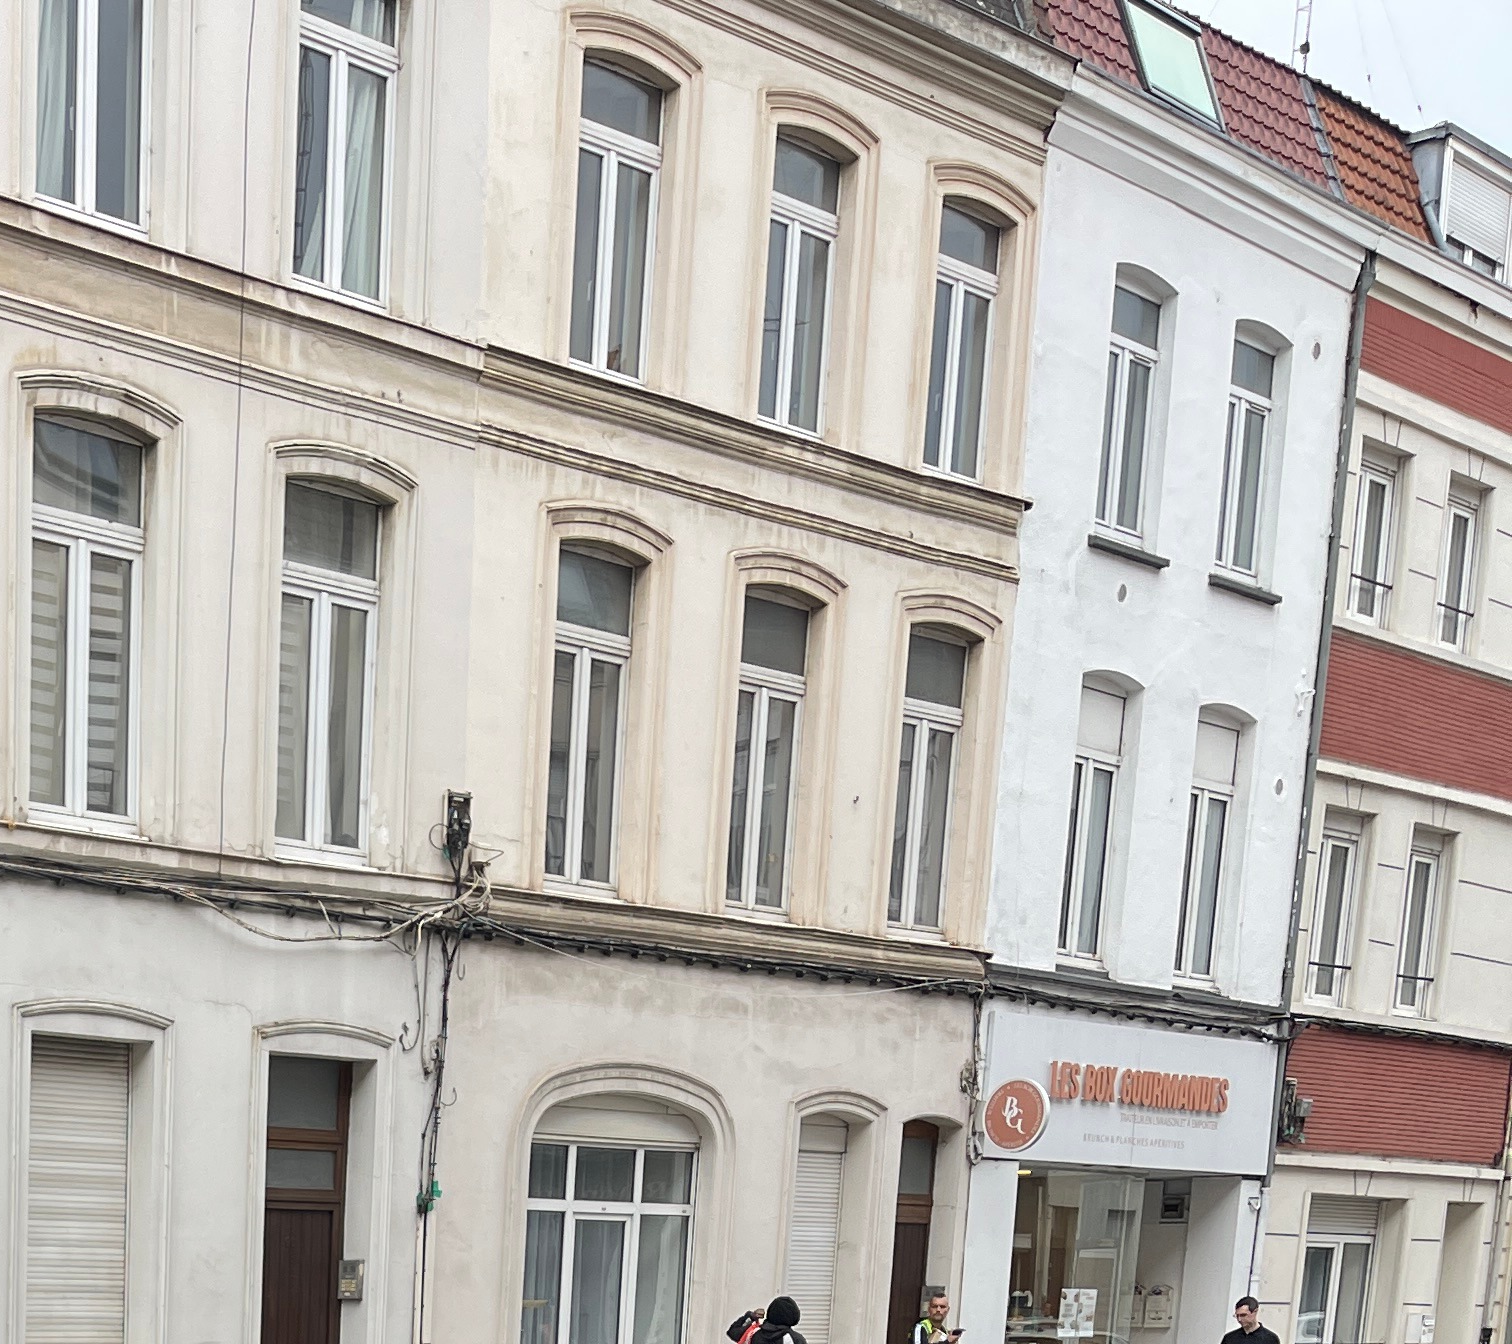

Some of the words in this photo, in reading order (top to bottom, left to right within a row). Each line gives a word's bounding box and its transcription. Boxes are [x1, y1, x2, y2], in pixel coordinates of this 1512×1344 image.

[1049, 1060, 1081, 1099] LES
[1082, 1064, 1119, 1104] BOX
[1119, 1068, 1230, 1114] GOURMANDES
